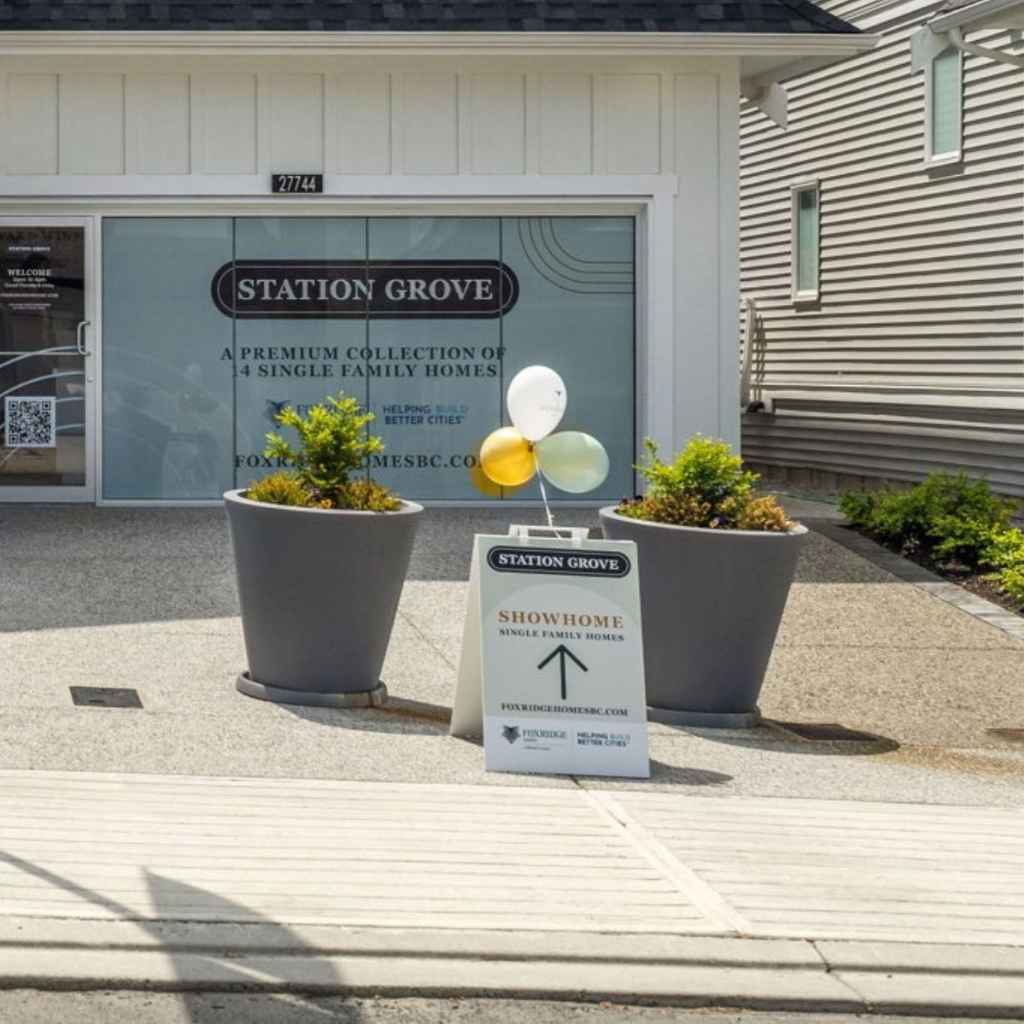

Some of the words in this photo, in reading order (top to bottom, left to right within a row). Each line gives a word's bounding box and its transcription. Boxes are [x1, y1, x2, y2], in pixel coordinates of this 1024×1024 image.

[279, 175, 316, 192] 27744
[7, 269, 51, 277] WELCOME
[237, 278, 374, 301] STATION
[384, 278, 494, 301] GROVE
[220, 347, 233, 360] A
[240, 347, 339, 360] PREMIUM
[346, 347, 476, 360] COLLECTION
[481, 347, 507, 360] OF
[257, 364, 334, 377] SINGLE
[341, 364, 417, 377] FAMILY
[425, 364, 497, 377] HOMES
[383, 404, 432, 414] HELPING
[384, 416, 424, 425] BETTER
[498, 553, 564, 568] STATION
[567, 557, 620, 571] GROVE
[497, 609, 625, 629] SHOWHOME
[499, 628, 539, 638] SINGLE
[542, 631, 583, 640] FAMILY
[585, 633, 625, 642] HOMES
[501, 702, 629, 717] FOXRIDGEHOMESBC.COM
